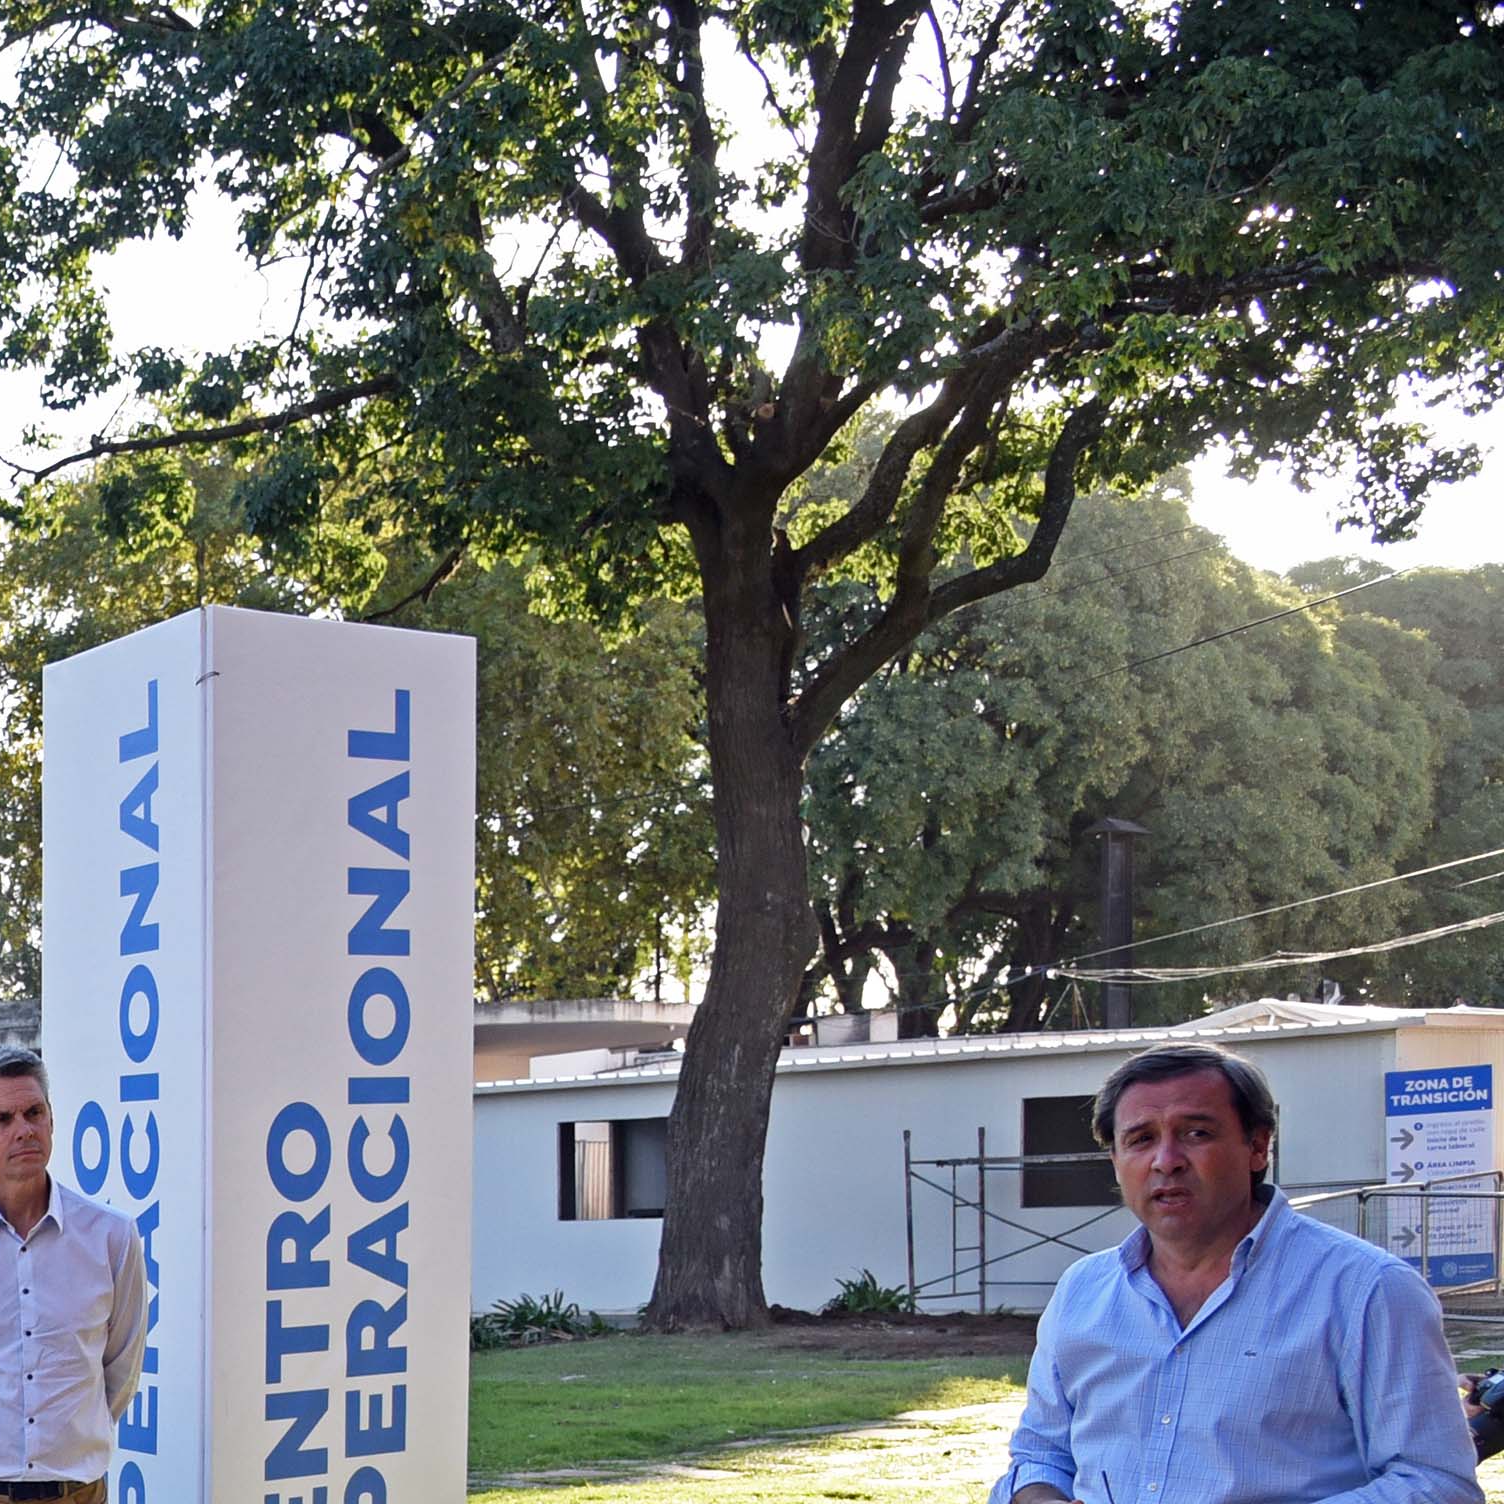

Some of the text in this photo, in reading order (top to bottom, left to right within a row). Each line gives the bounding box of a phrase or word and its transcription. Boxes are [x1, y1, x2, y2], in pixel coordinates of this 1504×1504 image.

[1404, 1076, 1473, 1092] ZONA DE
[1390, 1087, 1488, 1106] TRANSICIÓN
